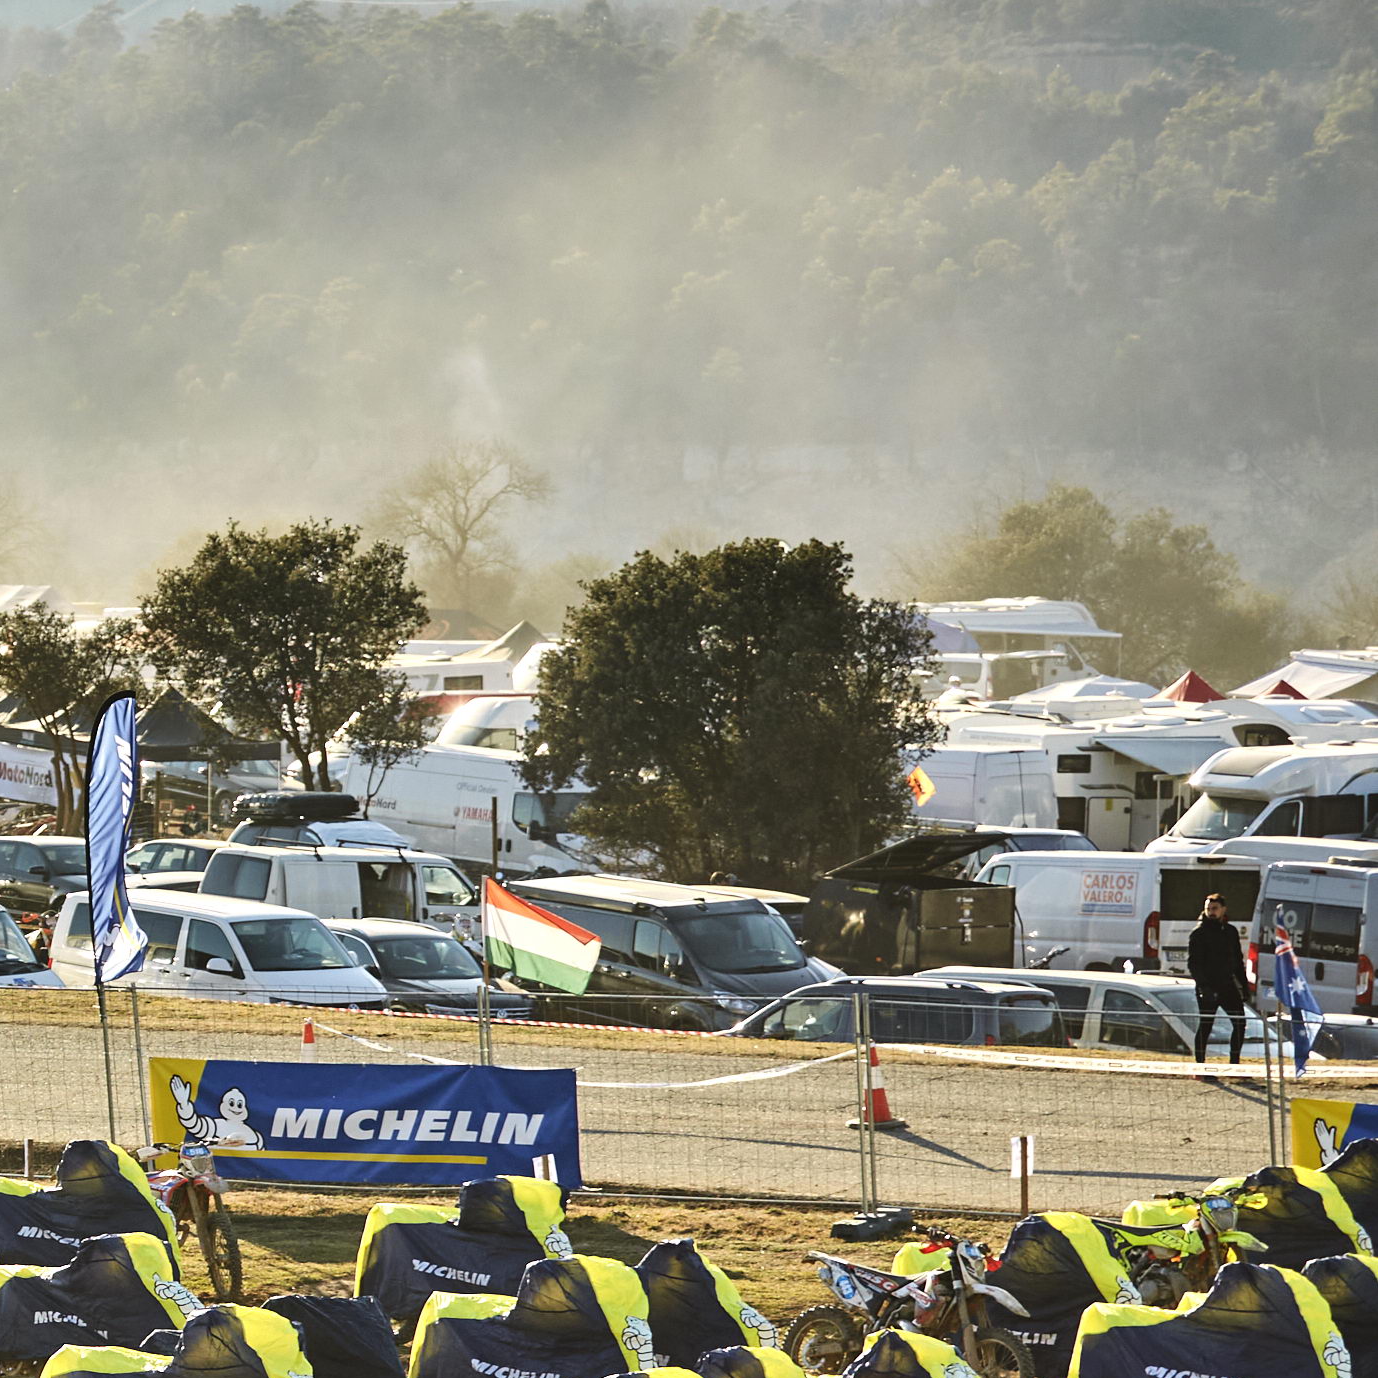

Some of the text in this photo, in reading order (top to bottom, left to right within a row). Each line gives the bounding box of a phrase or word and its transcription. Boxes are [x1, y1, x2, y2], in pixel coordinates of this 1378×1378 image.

[1083, 875, 1134, 891] CARLOS
[1083, 889, 1125, 903] VALERO
[270, 1107, 545, 1146] MICHELIN
[411, 1258, 492, 1287] MICHELIN
